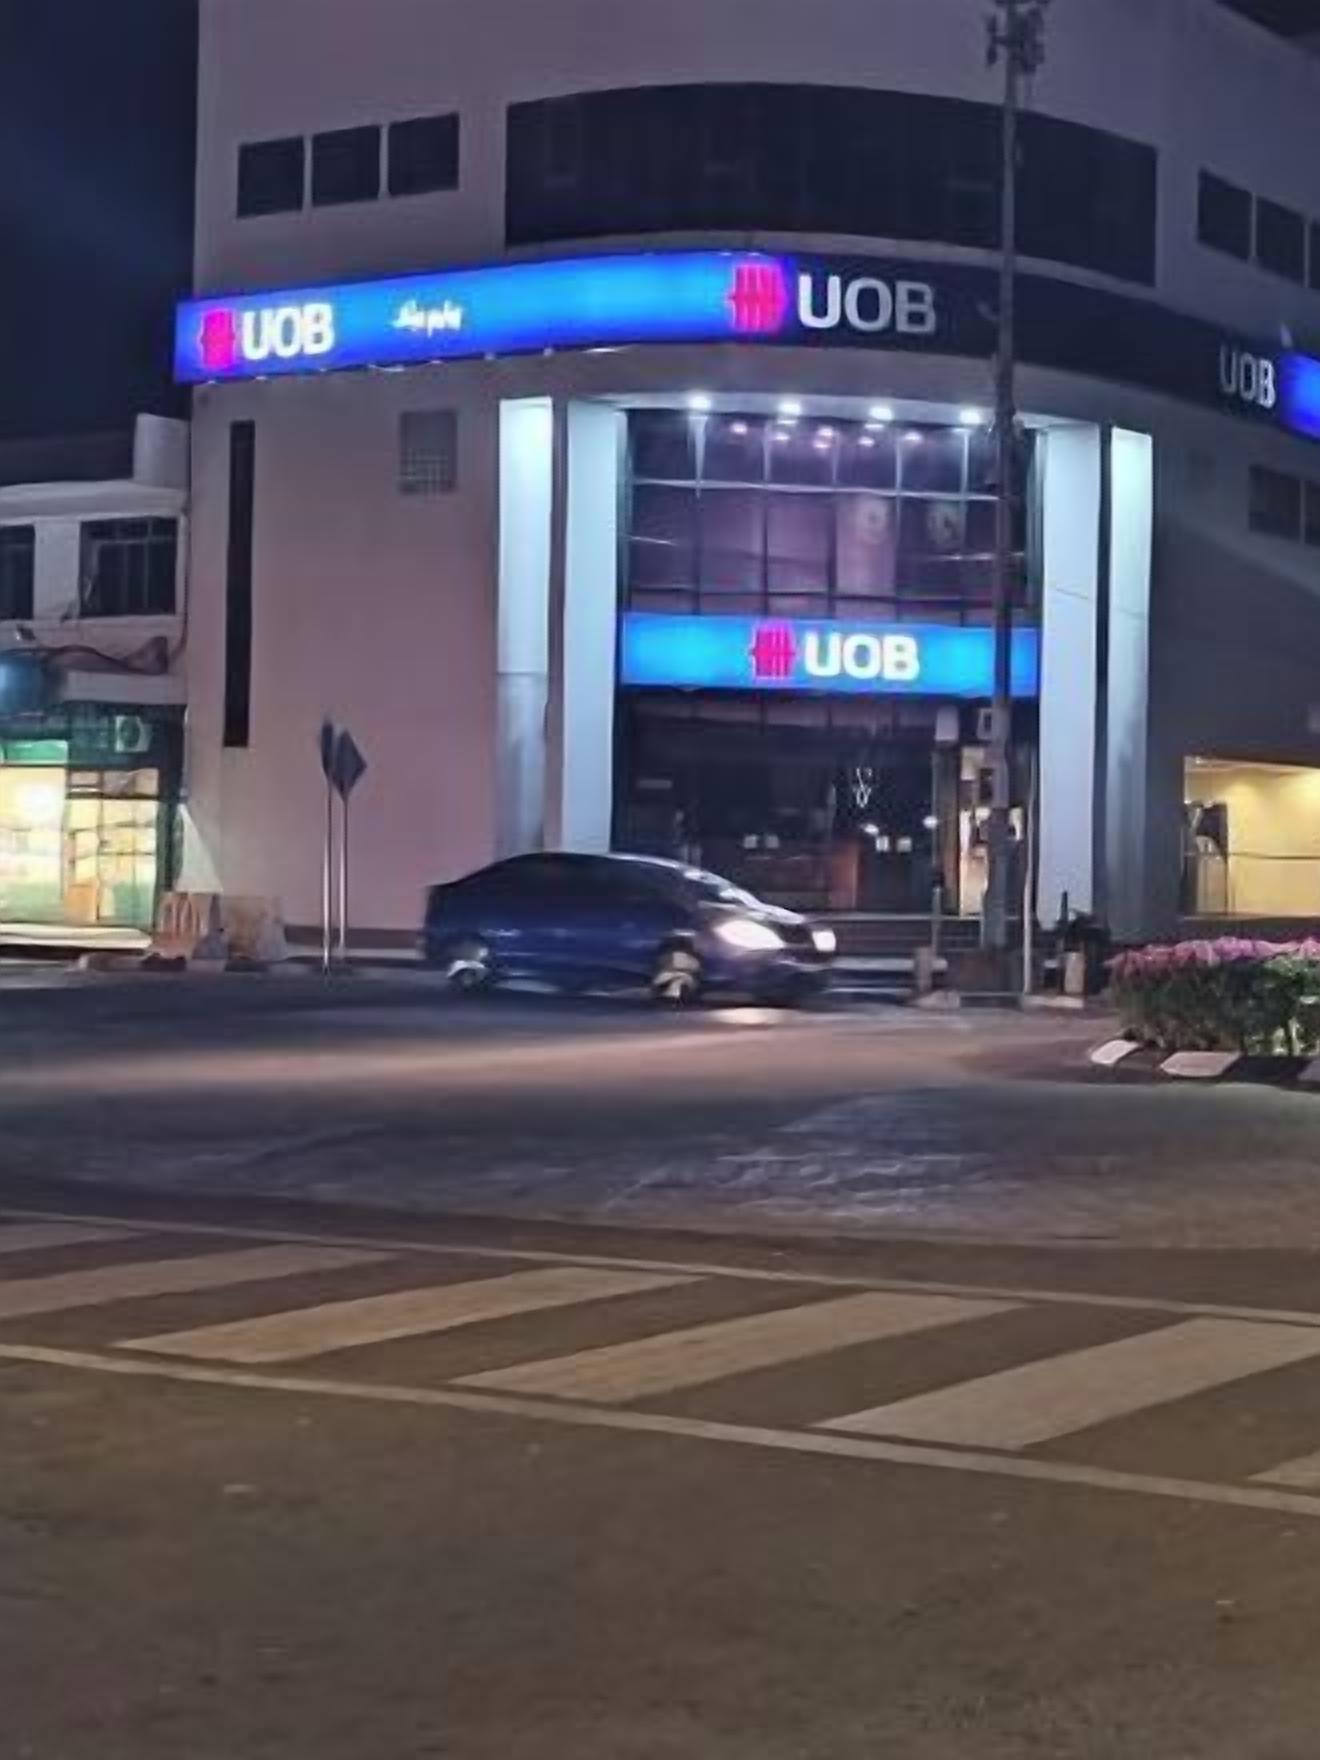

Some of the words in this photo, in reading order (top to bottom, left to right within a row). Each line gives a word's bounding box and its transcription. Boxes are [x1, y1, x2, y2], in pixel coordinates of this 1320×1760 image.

[242, 303, 334, 360] UOB
[799, 273, 936, 335] UOB
[1219, 345, 1276, 409] UOB
[804, 630, 920, 680] UOB
